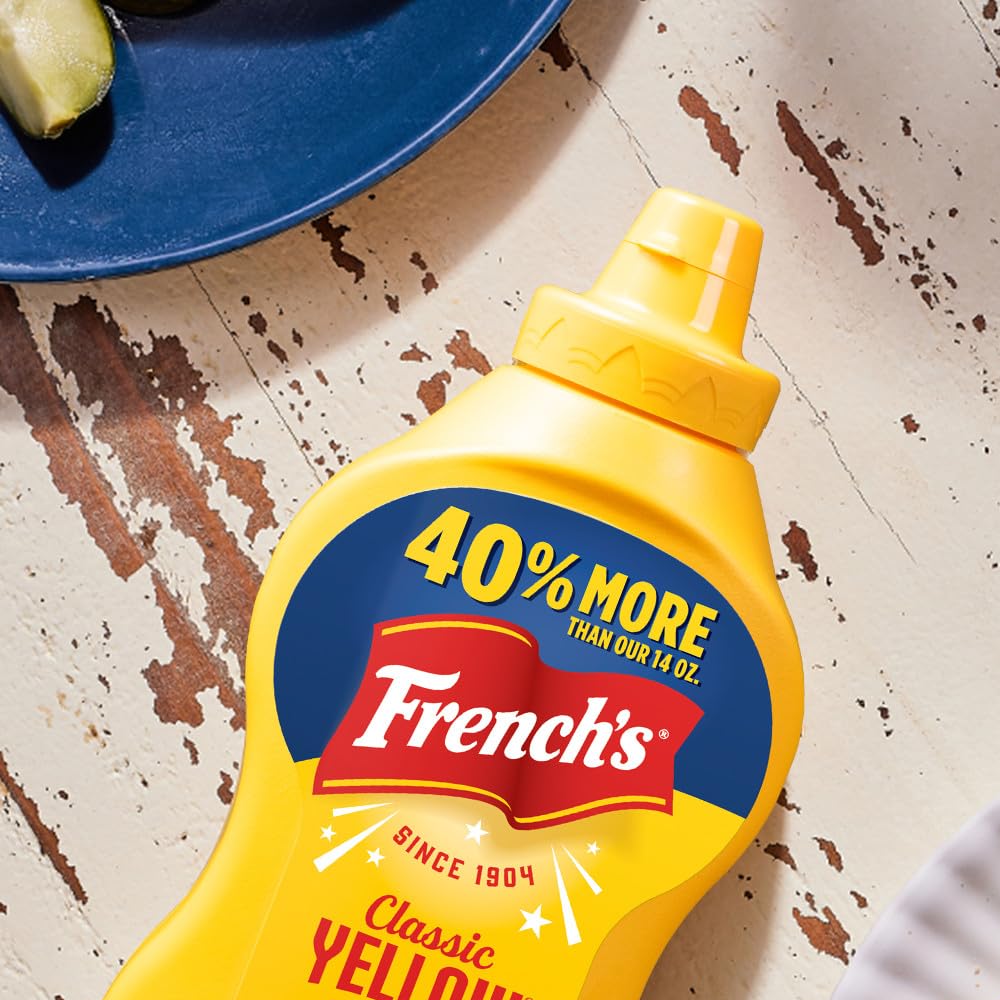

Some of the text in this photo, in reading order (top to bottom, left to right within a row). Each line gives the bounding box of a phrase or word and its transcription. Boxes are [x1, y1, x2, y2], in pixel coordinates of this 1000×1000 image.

[404, 505, 719, 658] 40% MORE
[567, 615, 700, 685] THAN OUR 14 OZ.
[392, 825, 535, 888] SINCE 1904
[364, 894, 496, 970] Classic
